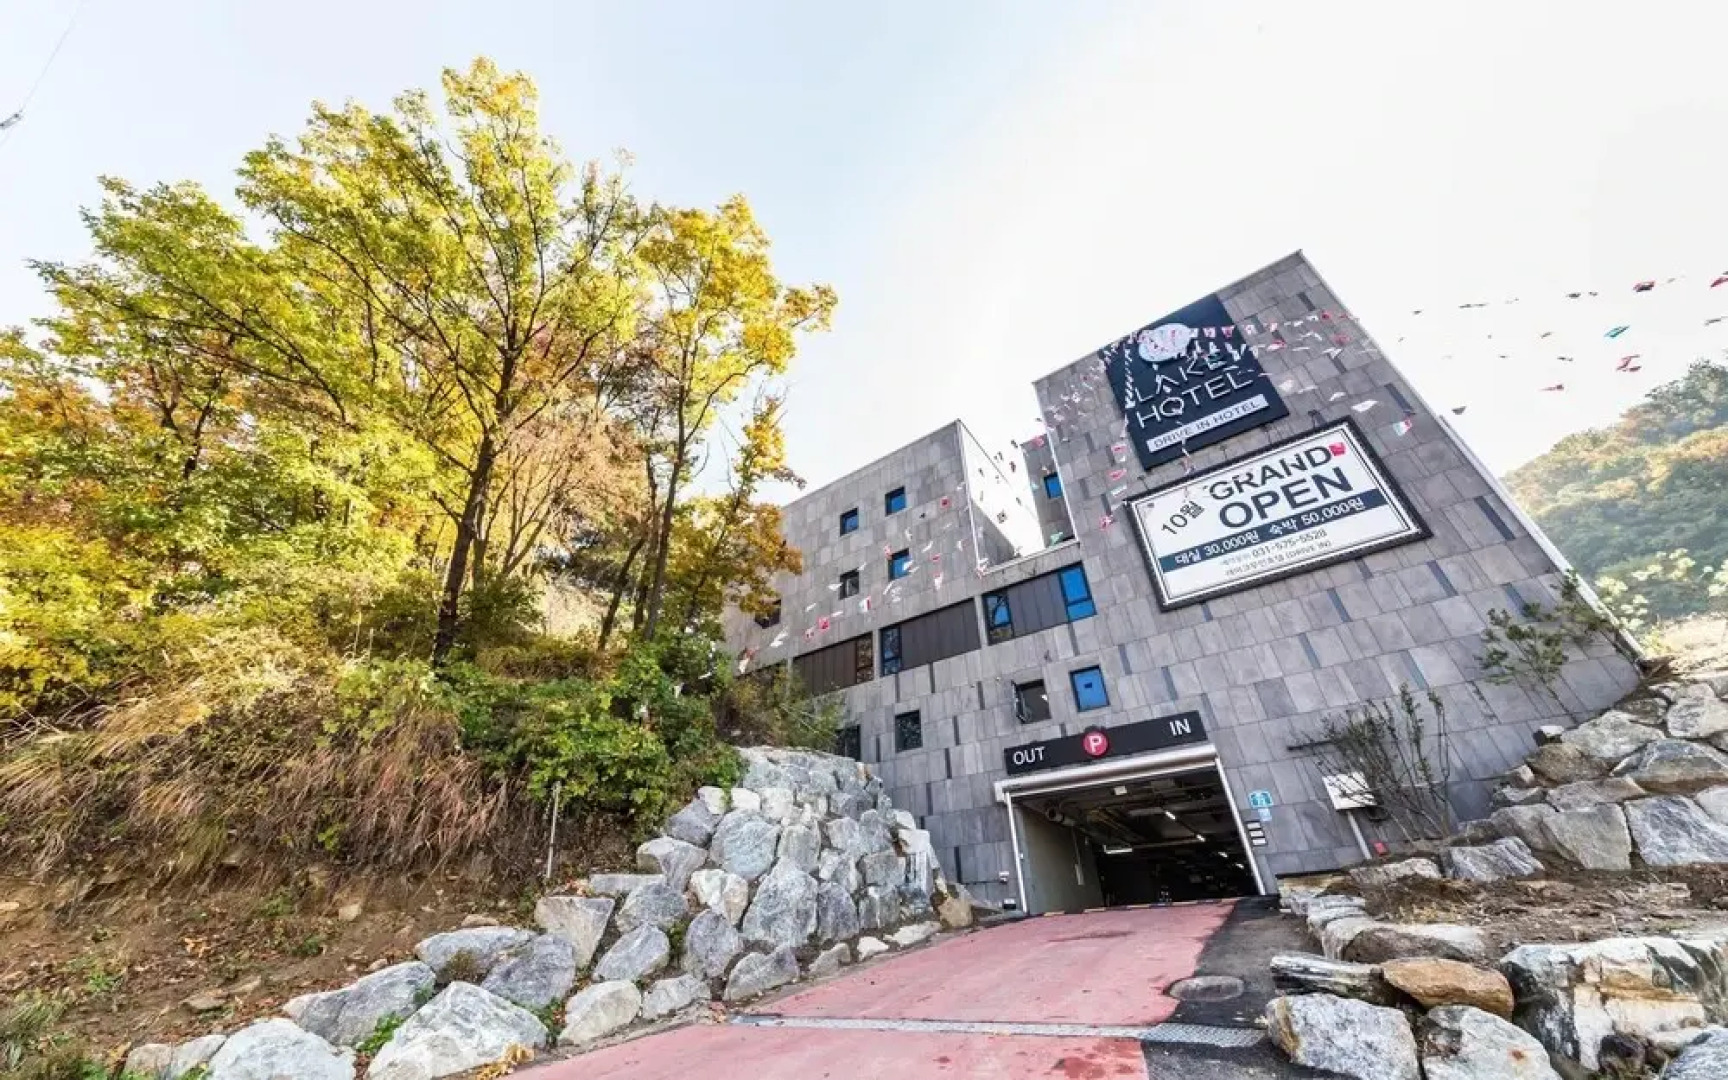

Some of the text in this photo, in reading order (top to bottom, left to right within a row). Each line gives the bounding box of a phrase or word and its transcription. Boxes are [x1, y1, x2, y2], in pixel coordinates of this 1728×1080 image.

[1136, 372, 1254, 428] HOTEL
[1153, 402, 1260, 448] DRIVE IN HOTEL
[1209, 446, 1332, 500] GRAND
[1161, 500, 1205, 535] 10월
[1219, 466, 1354, 528] OPEN
[1175, 549, 1202, 565] 대실
[1204, 530, 1259, 558] 30,000원
[1301, 497, 1365, 525] 50,000원
[1089, 735, 1102, 753] P
[1169, 718, 1192, 735] IN
[1013, 746, 1045, 765] OUT
